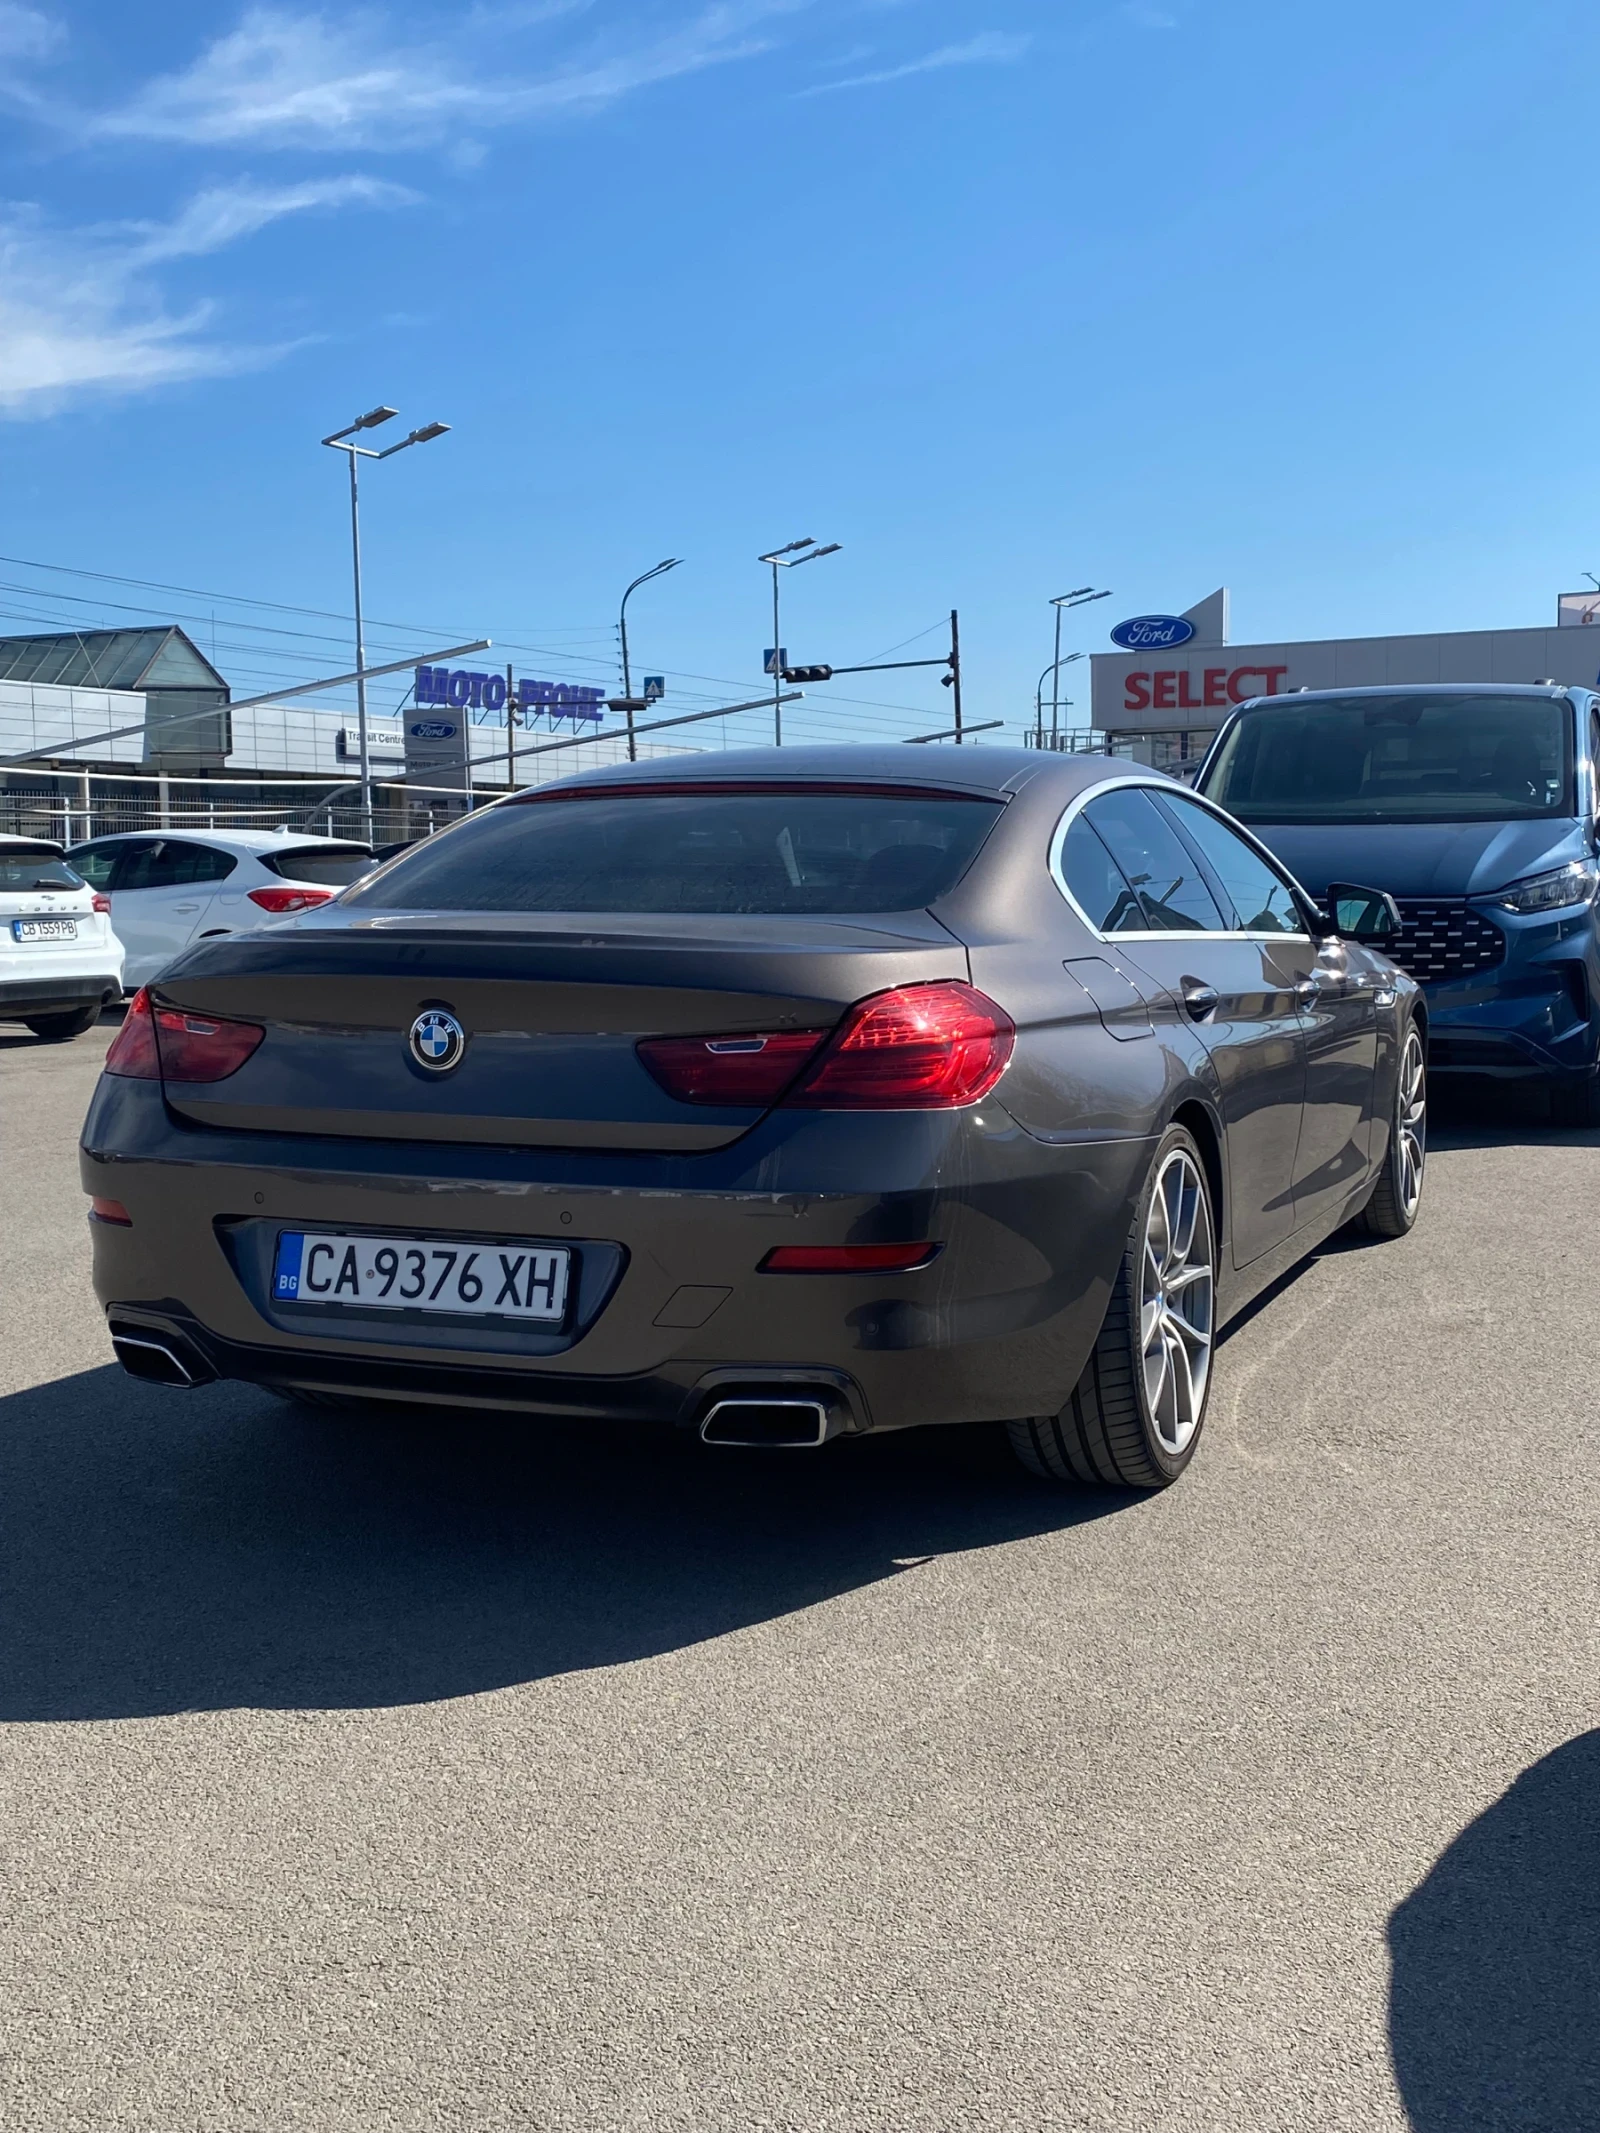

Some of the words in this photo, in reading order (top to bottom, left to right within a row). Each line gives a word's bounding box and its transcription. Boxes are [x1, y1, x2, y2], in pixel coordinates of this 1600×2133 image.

[1127, 620, 1176, 643] Ford
[1124, 665, 1287, 710] SELECT
[347, 731, 377, 743] Trasit
[378, 733, 406, 745] Centre
[417, 723, 446, 737] Ford
[22, 922, 36, 936] CB
[38, 921, 60, 935] 1559
[61, 921, 75, 934] PB
[416, 1016, 455, 1033] BMW
[278, 1274, 298, 1290] BG
[306, 1243, 360, 1296] CA
[374, 1247, 483, 1304] 9376
[494, 1254, 558, 1310] XH
